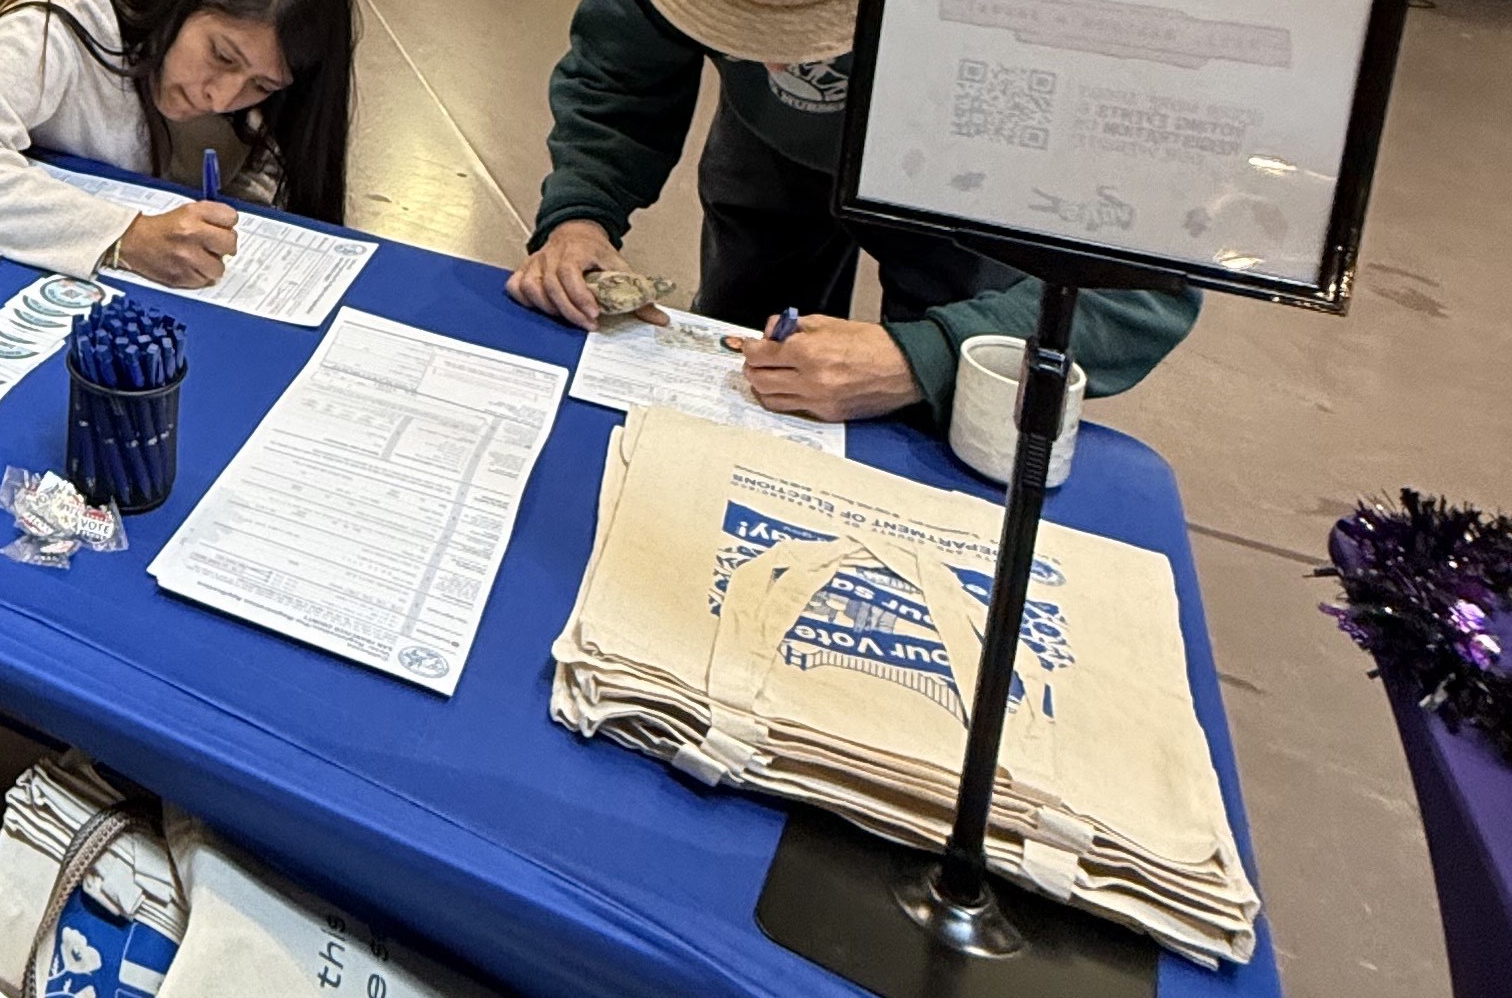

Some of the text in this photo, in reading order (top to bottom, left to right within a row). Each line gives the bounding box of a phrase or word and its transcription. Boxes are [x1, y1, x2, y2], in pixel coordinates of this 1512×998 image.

[732, 473, 834, 512] ELECTIONS
[80, 517, 110, 534] VOTE
[839, 510, 866, 523] OF
[794, 623, 884, 657] Vote
[317, 914, 346, 988] this
